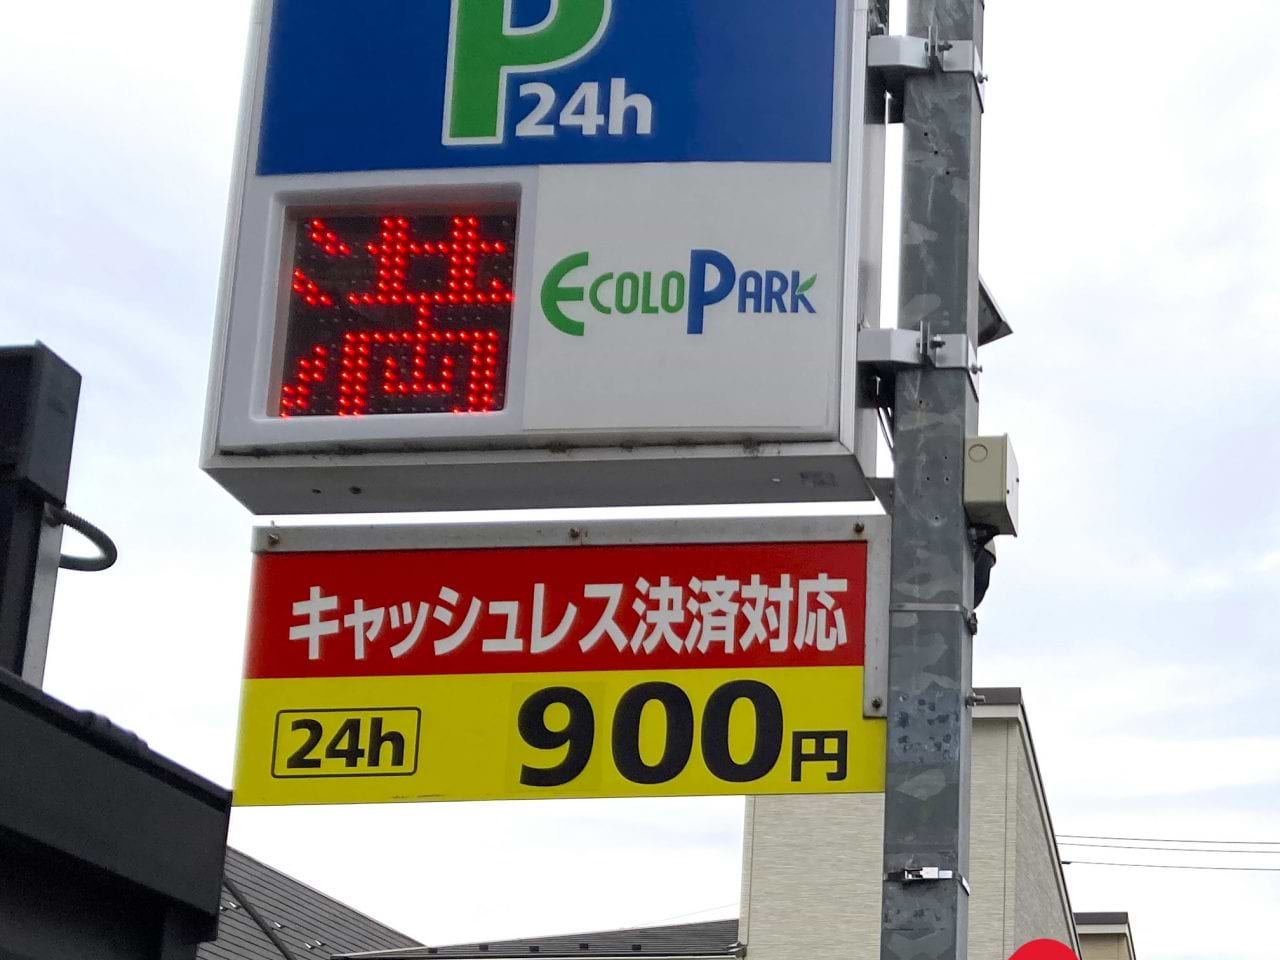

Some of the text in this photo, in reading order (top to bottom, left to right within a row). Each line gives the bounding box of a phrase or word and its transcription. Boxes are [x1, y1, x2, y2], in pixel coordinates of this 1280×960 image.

[514, 80, 653, 138] 24h
[279, 214, 516, 418] 満
[288, 573, 849, 661] キャッシュレス決済対応
[284, 679, 849, 787] 24h 900円
